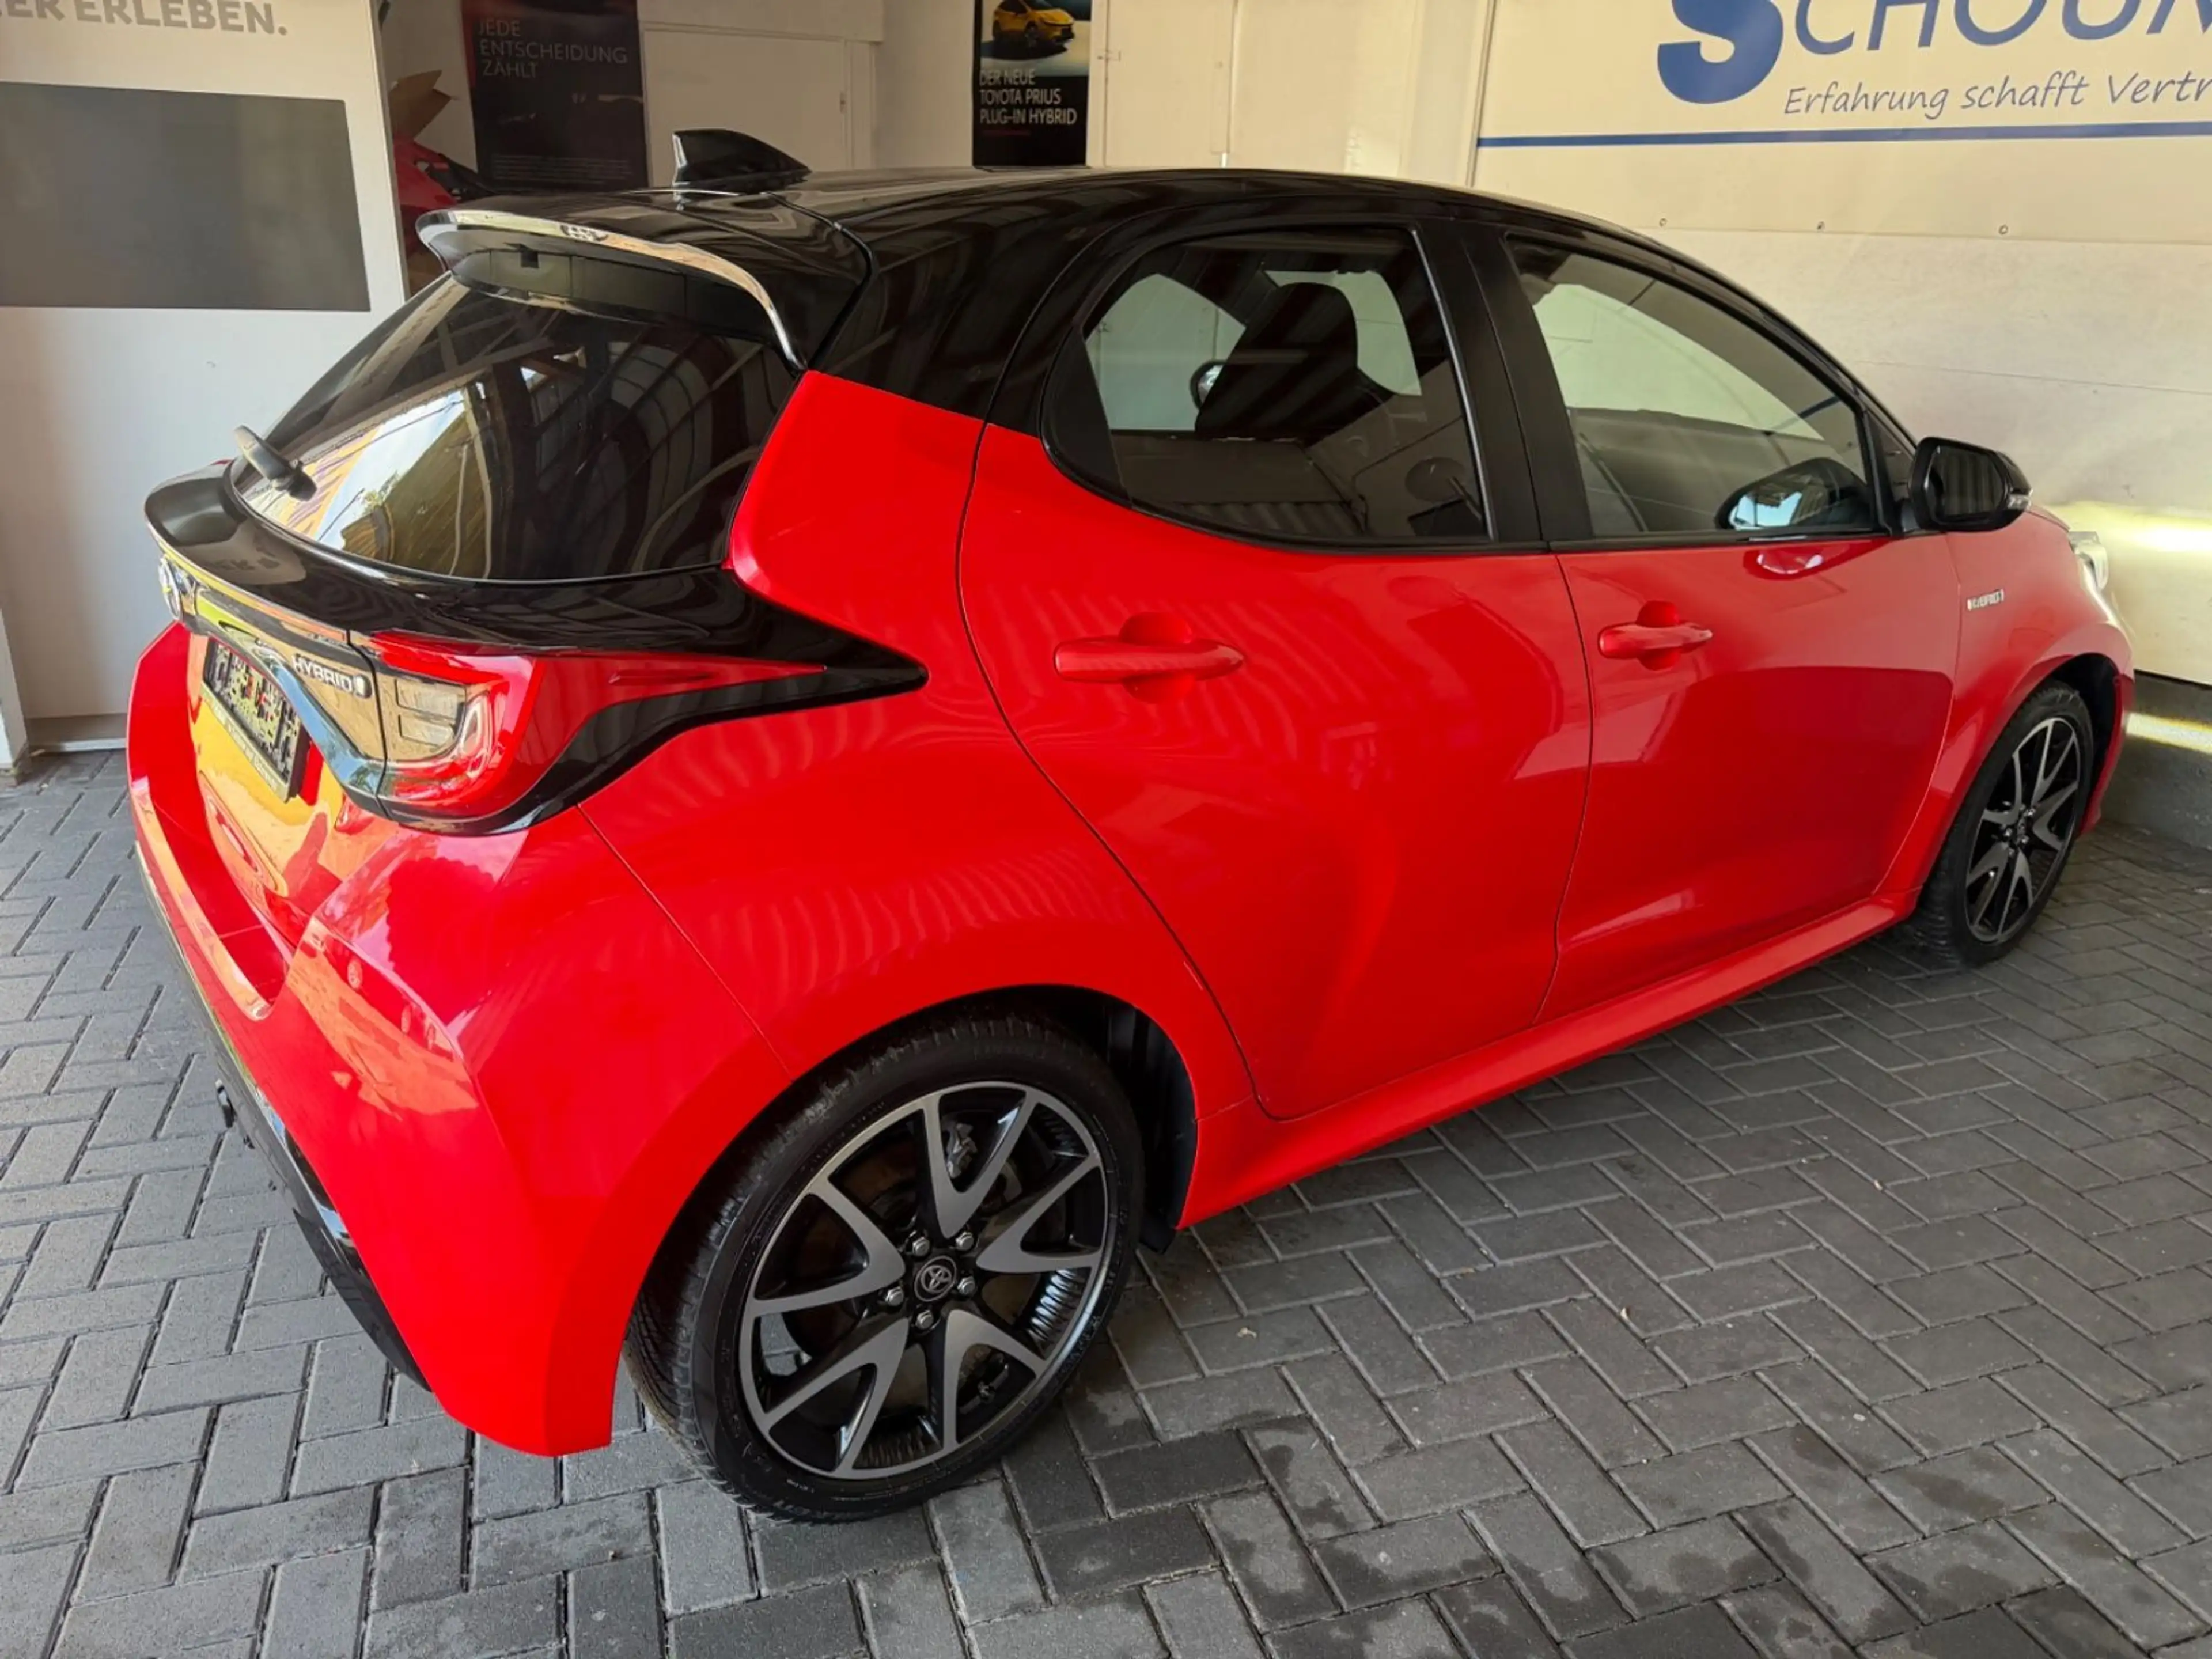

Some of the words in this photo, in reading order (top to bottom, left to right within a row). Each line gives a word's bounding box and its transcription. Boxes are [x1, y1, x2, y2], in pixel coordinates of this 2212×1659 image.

[0, 0, 65, 21] ER
[74, 0, 287, 35] ERLEBEN.
[478, 17, 521, 37] JEDE
[480, 39, 628, 64] ENTSCHEIDUNG
[979, 69, 1001, 86] DER
[1004, 69, 1036, 85] NEUE
[979, 89, 1022, 105] TOYOTA
[1025, 88, 1062, 105] PRIUS
[1784, 81, 1949, 120] Erfahrung
[1961, 70, 2090, 109] schafft
[979, 108, 1026, 125] PLUG-IN
[1029, 108, 1077, 125] HYBRID
[292, 654, 353, 692] HYBRID
